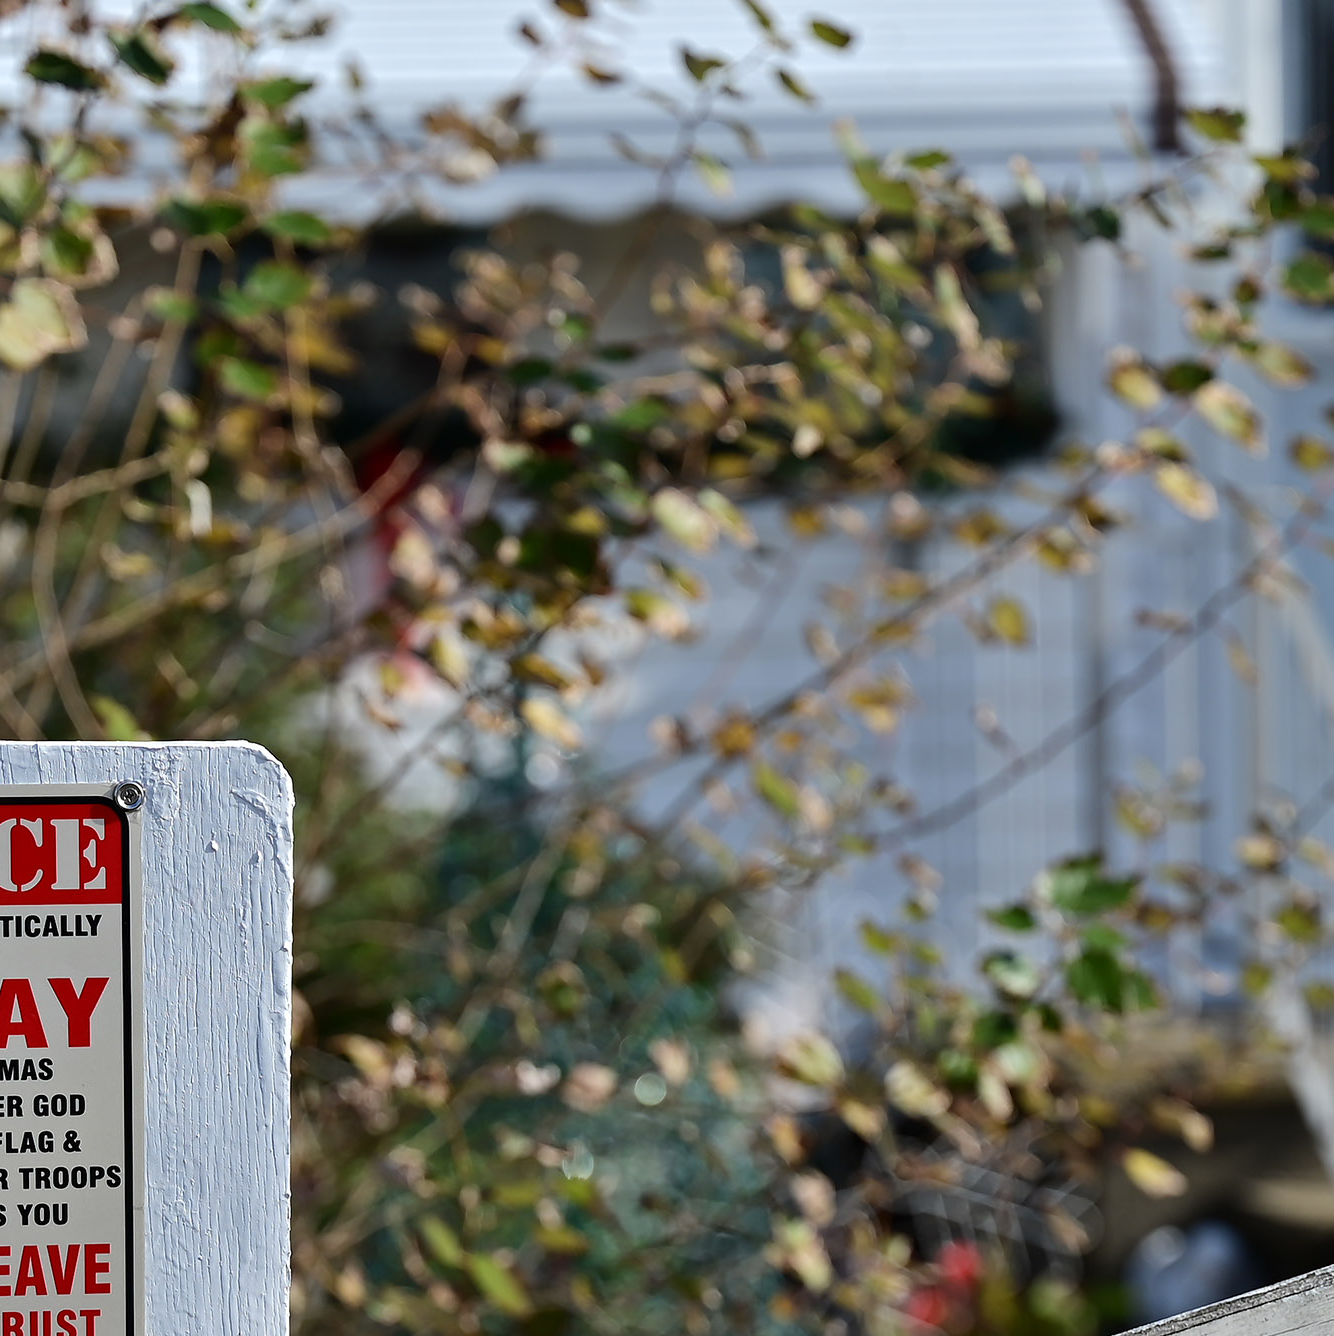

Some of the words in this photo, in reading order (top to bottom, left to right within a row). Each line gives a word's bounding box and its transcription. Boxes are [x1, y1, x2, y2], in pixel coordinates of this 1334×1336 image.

[33, 1093, 86, 1117] GOD
[62, 1130, 82, 1153] &
[18, 1165, 122, 1190] TROOPS
[16, 1203, 69, 1226] YOU
